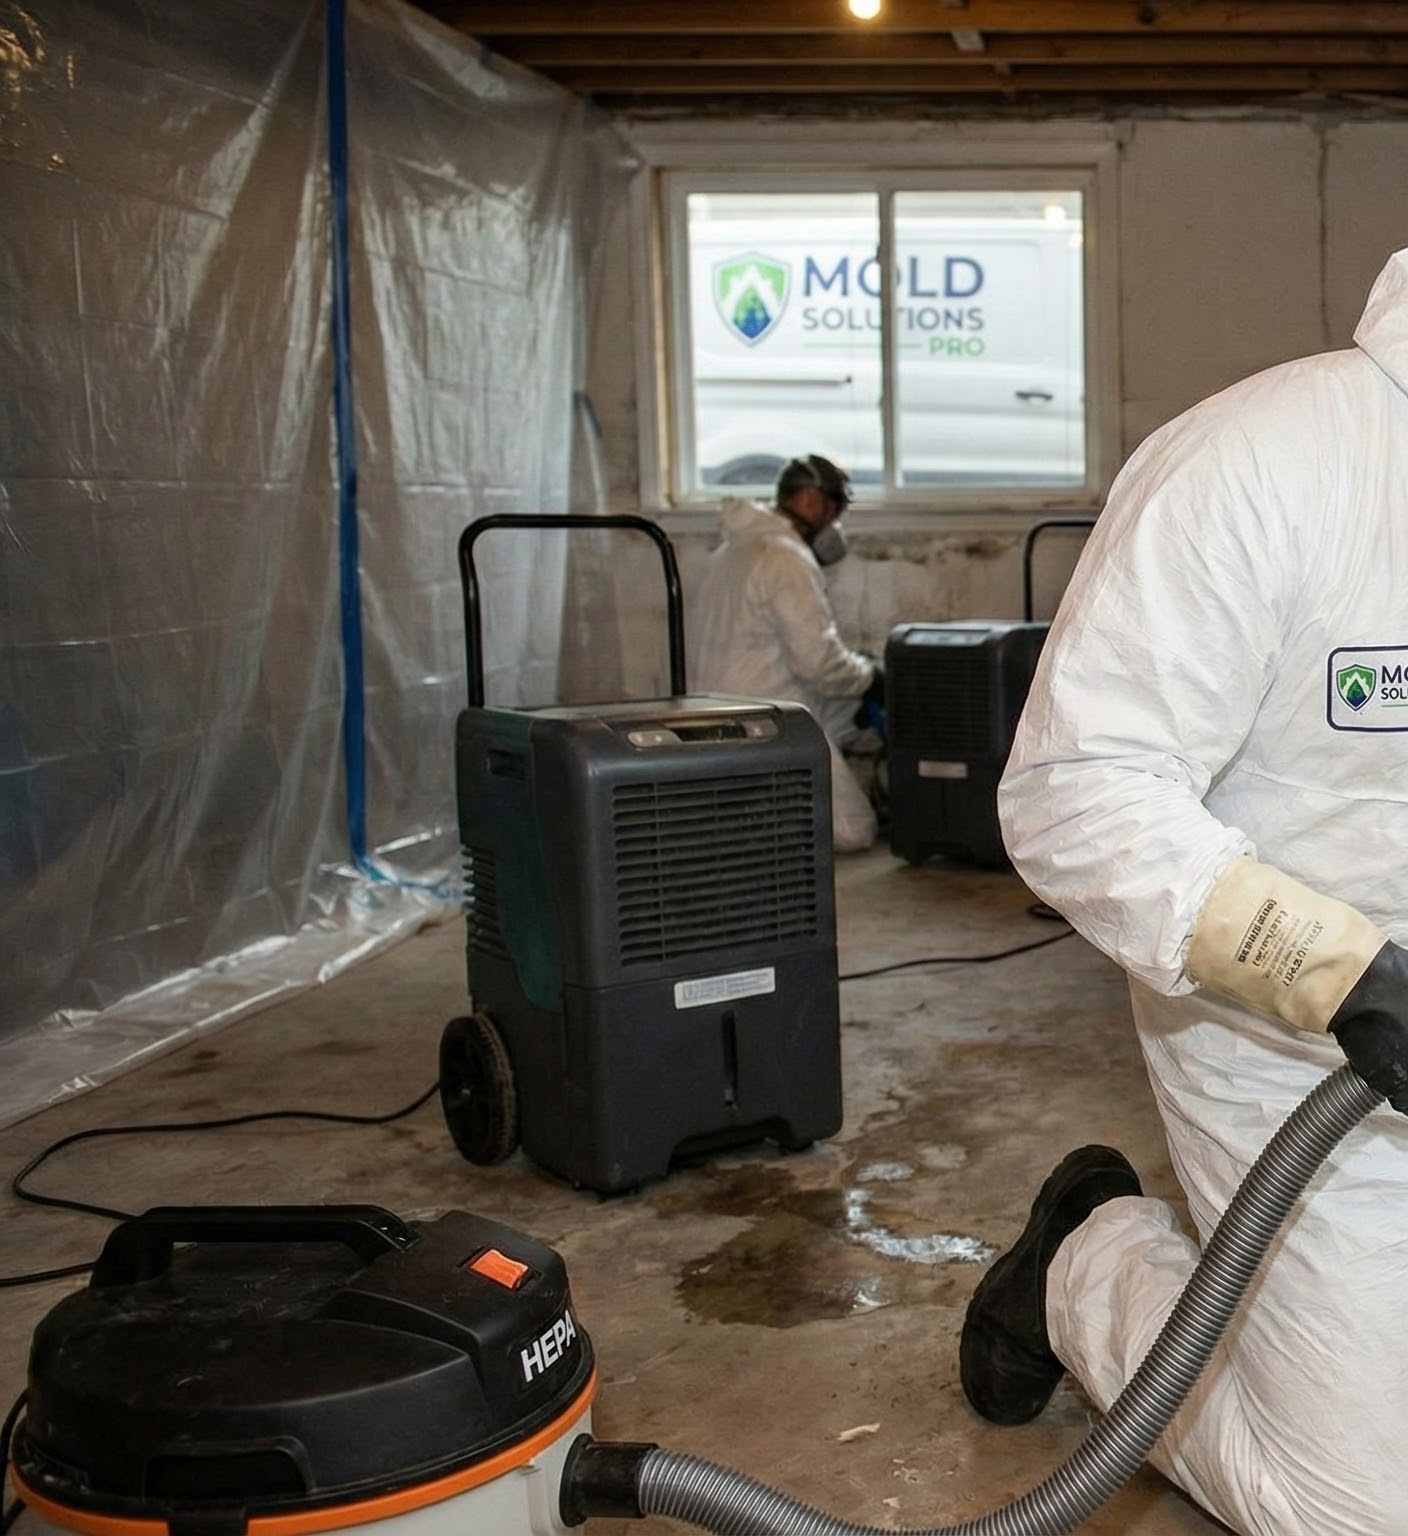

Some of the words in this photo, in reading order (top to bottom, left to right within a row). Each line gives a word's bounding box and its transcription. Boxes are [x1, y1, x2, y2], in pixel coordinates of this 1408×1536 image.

[803, 256, 984, 298] MOLD
[929, 337, 986, 356] PRO
[520, 1309, 576, 1383] HEPA
